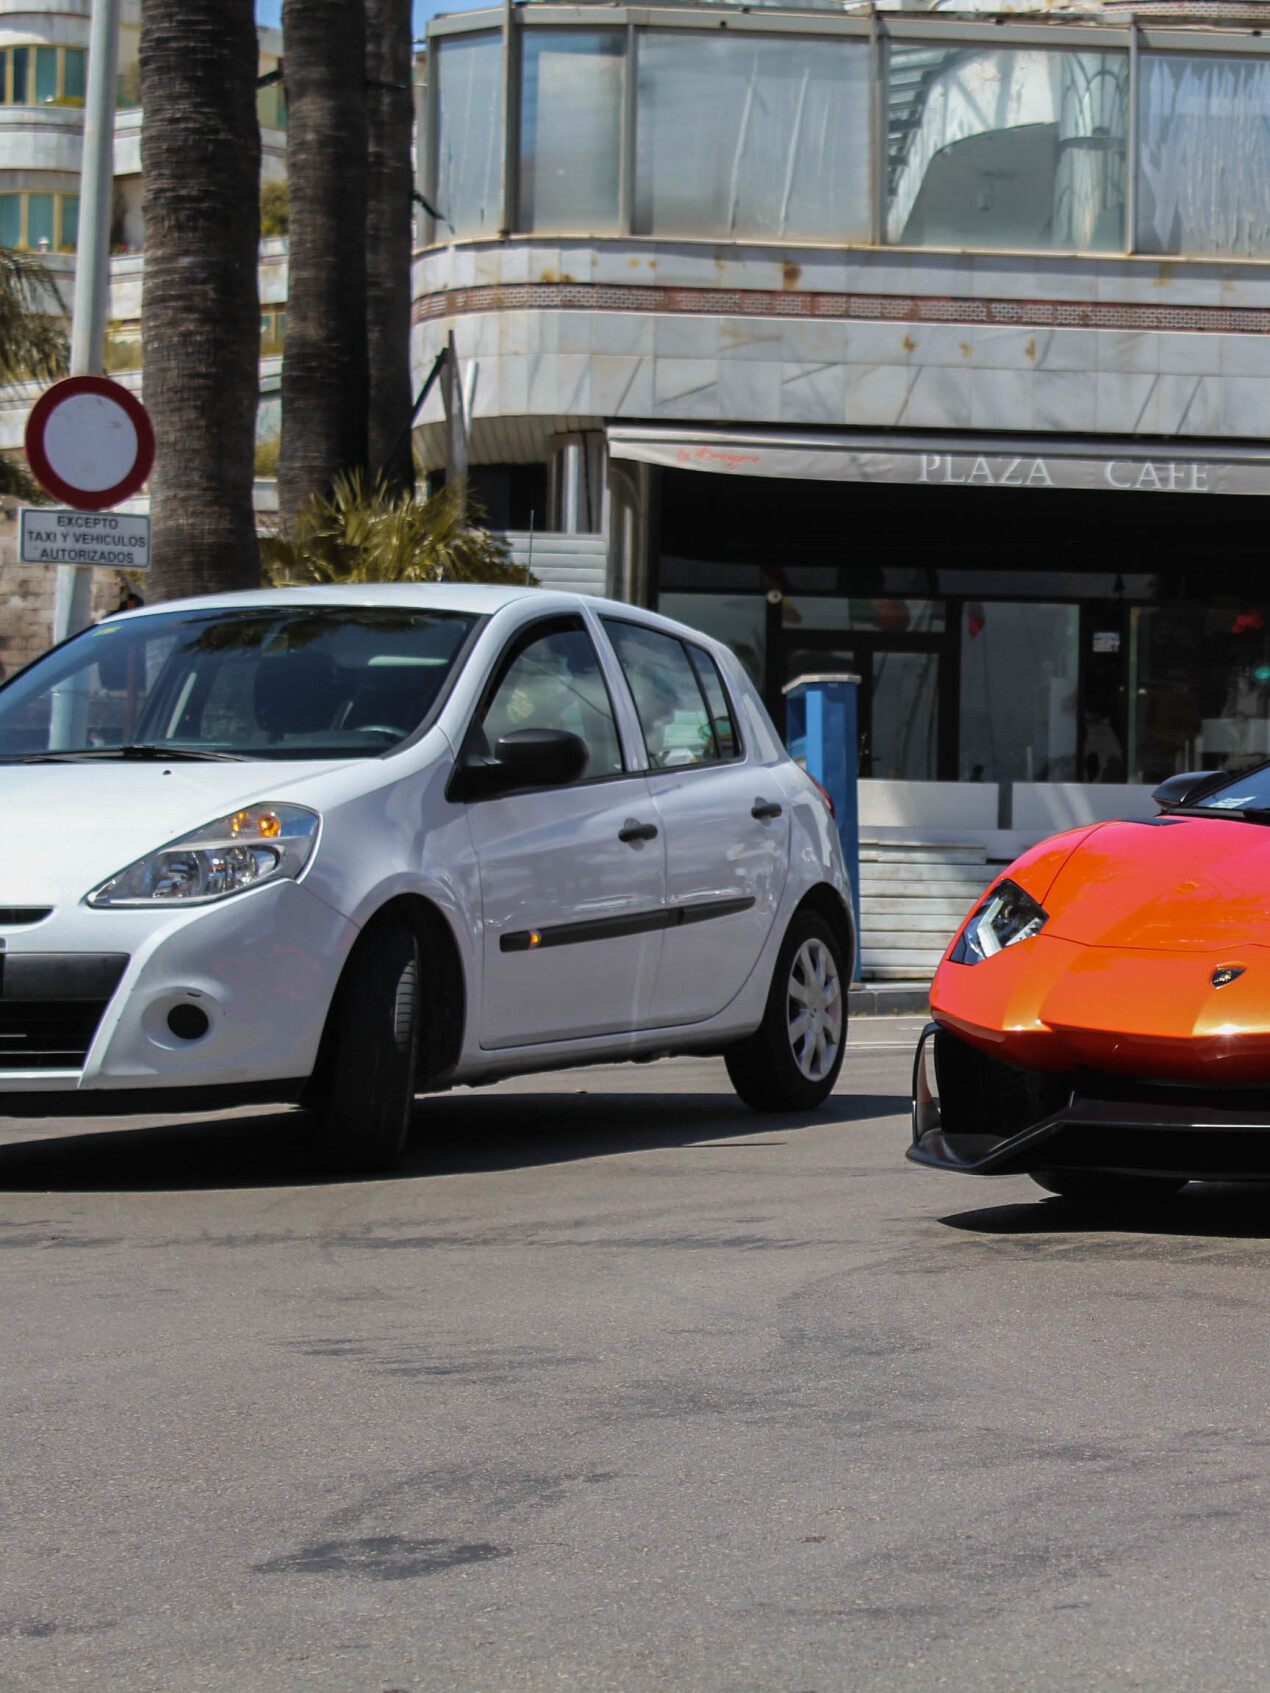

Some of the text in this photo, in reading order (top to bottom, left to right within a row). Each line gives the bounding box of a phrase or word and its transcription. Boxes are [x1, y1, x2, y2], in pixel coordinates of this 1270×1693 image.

[917, 452, 1209, 491] PLAZA CAFE
[57, 516, 119, 530] EXCEPTO
[27, 531, 147, 548] TAXI Y VEHICULOS
[40, 548, 135, 564] AUTORIZADOS
